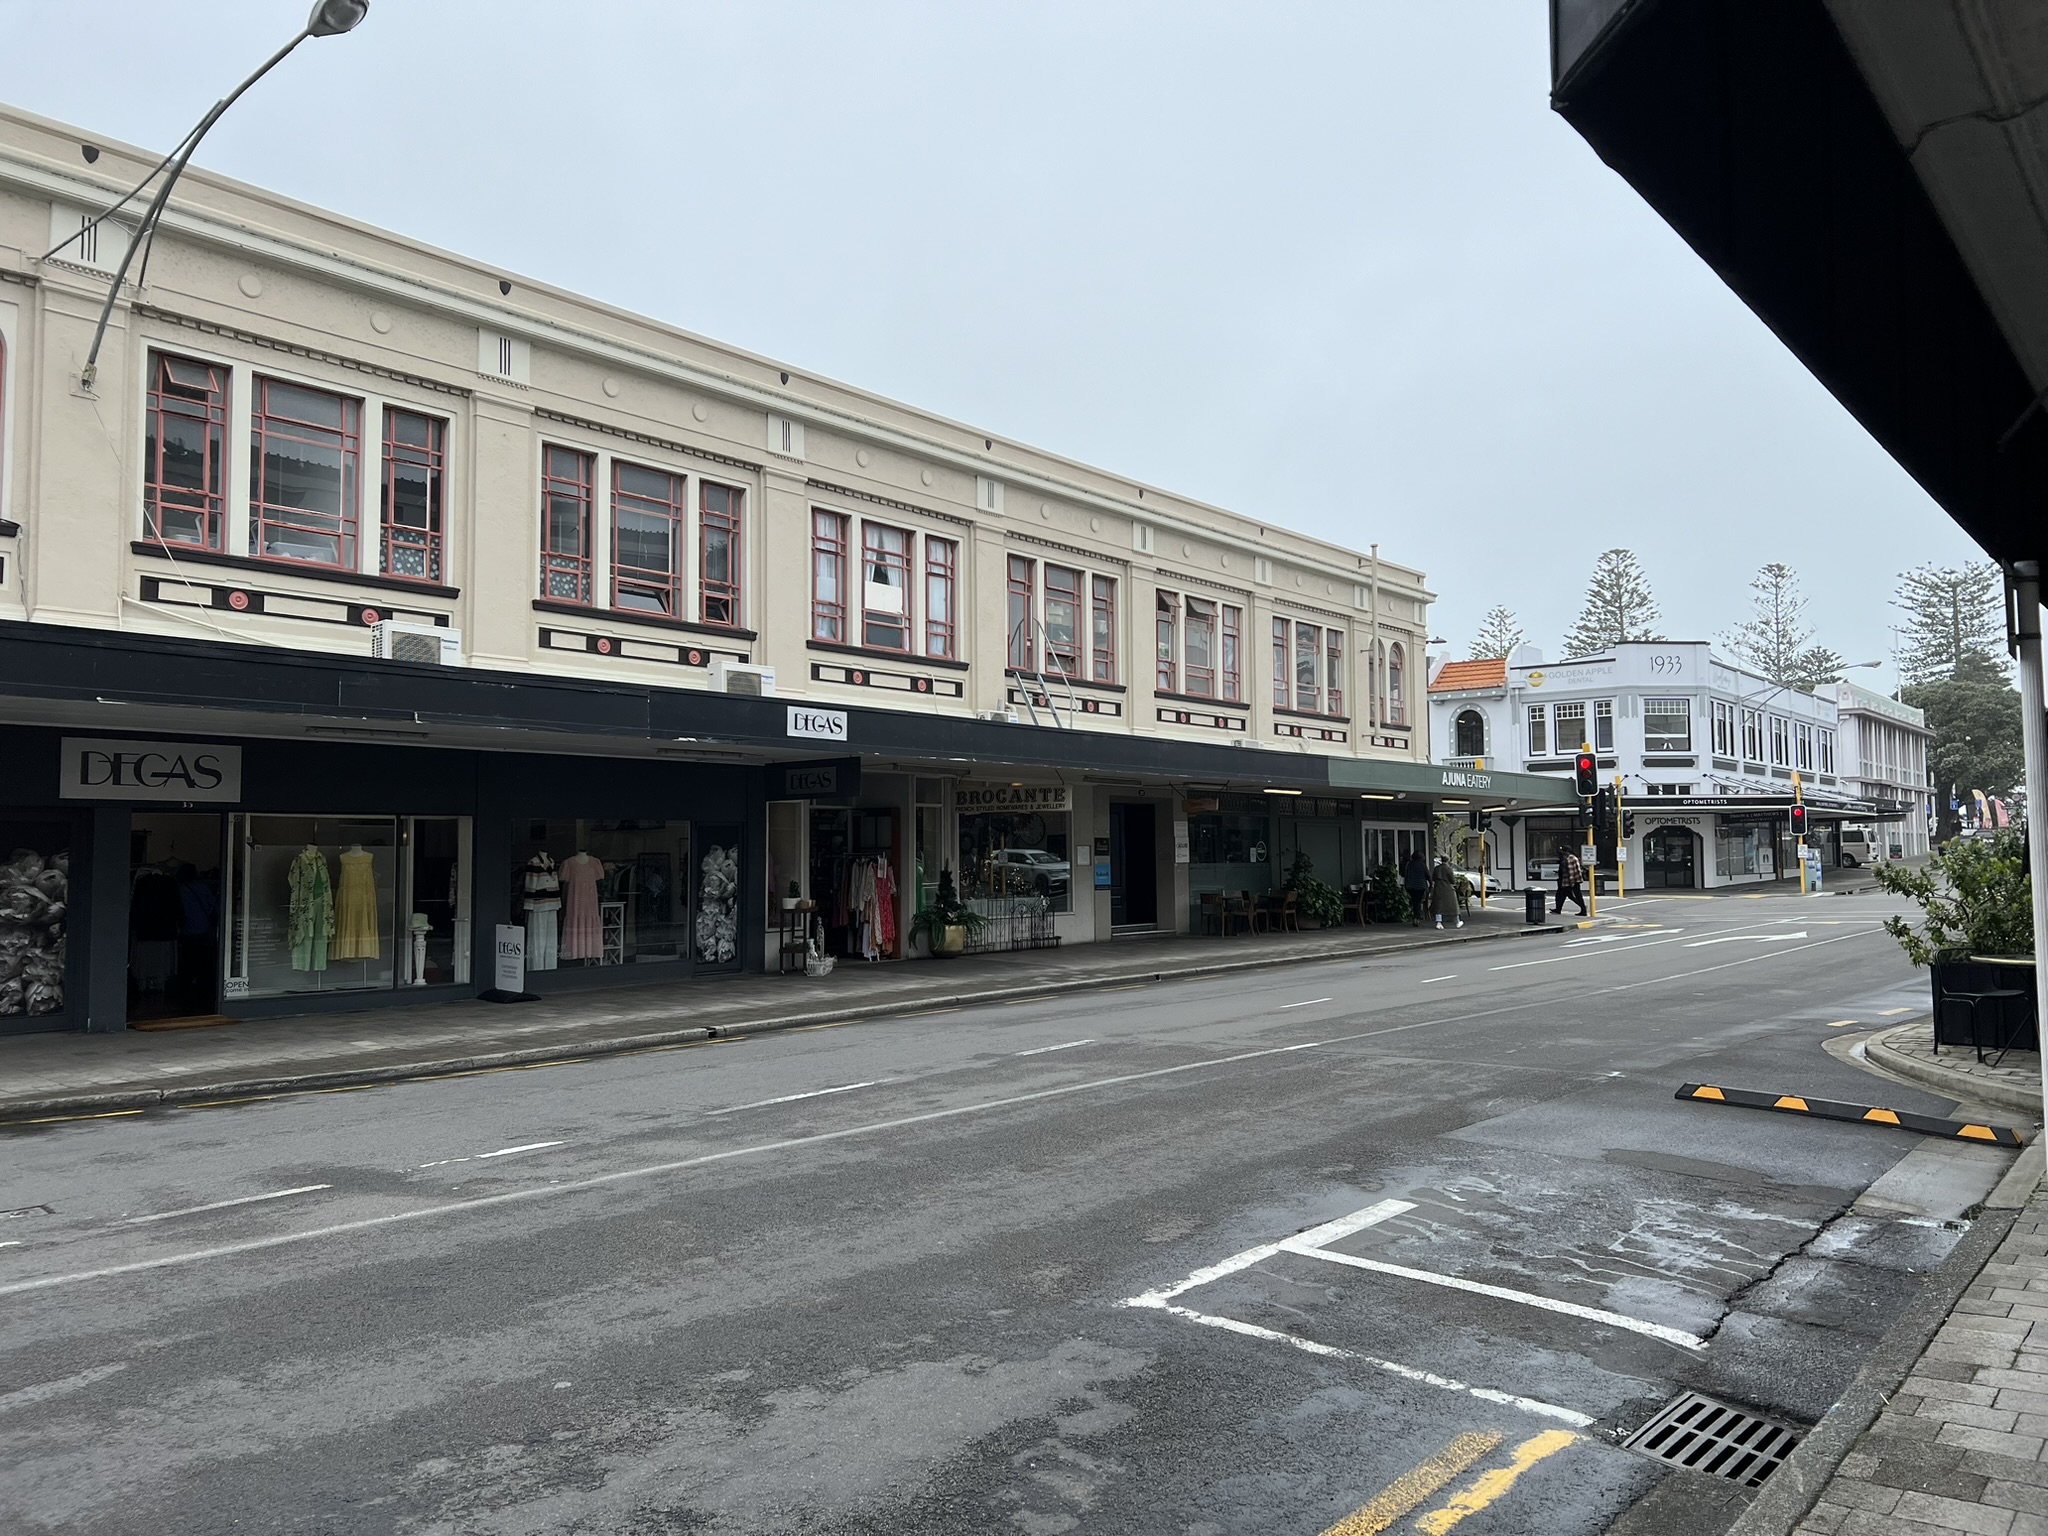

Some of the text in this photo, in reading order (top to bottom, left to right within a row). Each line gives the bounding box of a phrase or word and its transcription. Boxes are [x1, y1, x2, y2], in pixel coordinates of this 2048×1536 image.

[1548, 666, 1614, 680] GOLDEN APPLE
[1650, 655, 1683, 676] 1933
[1568, 677, 1594, 685] DENTAL
[794, 713, 843, 735] DEGAS
[80, 750, 223, 790] DEGAS
[790, 771, 832, 790] DEGAS
[1442, 771, 1492, 789] AJUNA EATERY
[955, 786, 1066, 806] BROCANTE
[1644, 816, 1701, 825] OPTOMETRISTS
[498, 941, 522, 956] DEGAS
